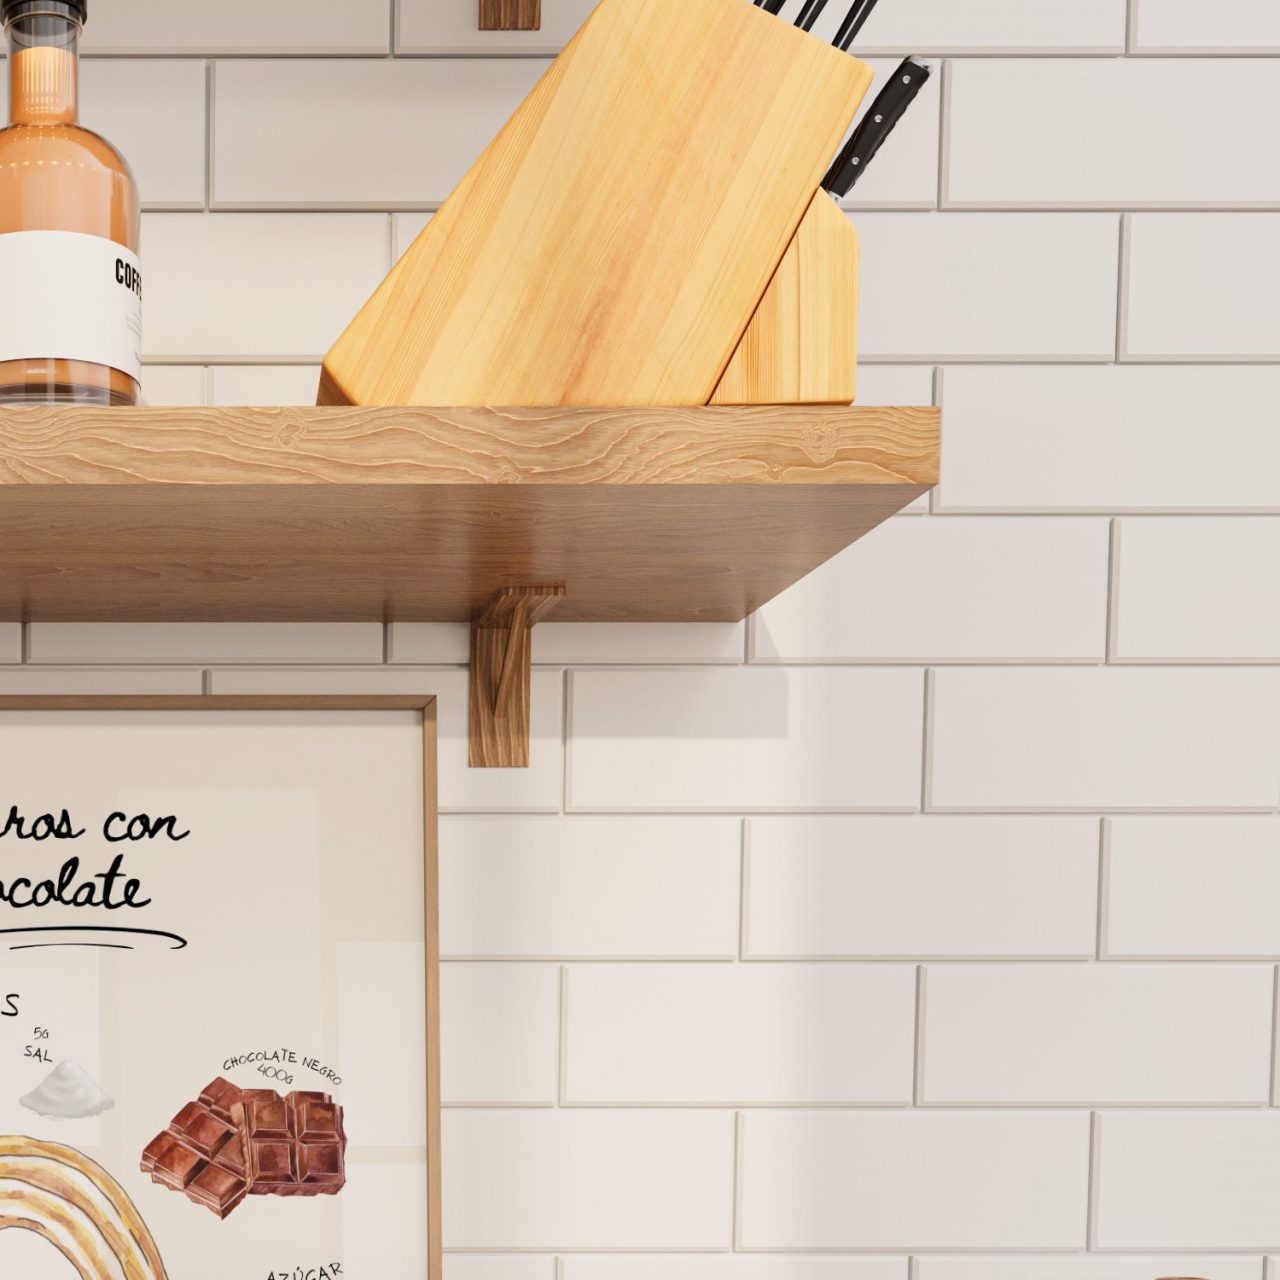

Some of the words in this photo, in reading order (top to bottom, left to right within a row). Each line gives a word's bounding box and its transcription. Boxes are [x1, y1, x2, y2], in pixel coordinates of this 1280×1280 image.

[115, 258, 142, 301] COFF
[103, 810, 191, 842] con
[33, 1026, 49, 1040] 5G
[23, 1044, 53, 1063] SAL
[222, 1048, 298, 1071] CHOCOLATE
[302, 1056, 342, 1086] NEGRO
[257, 1063, 294, 1085] 400G
